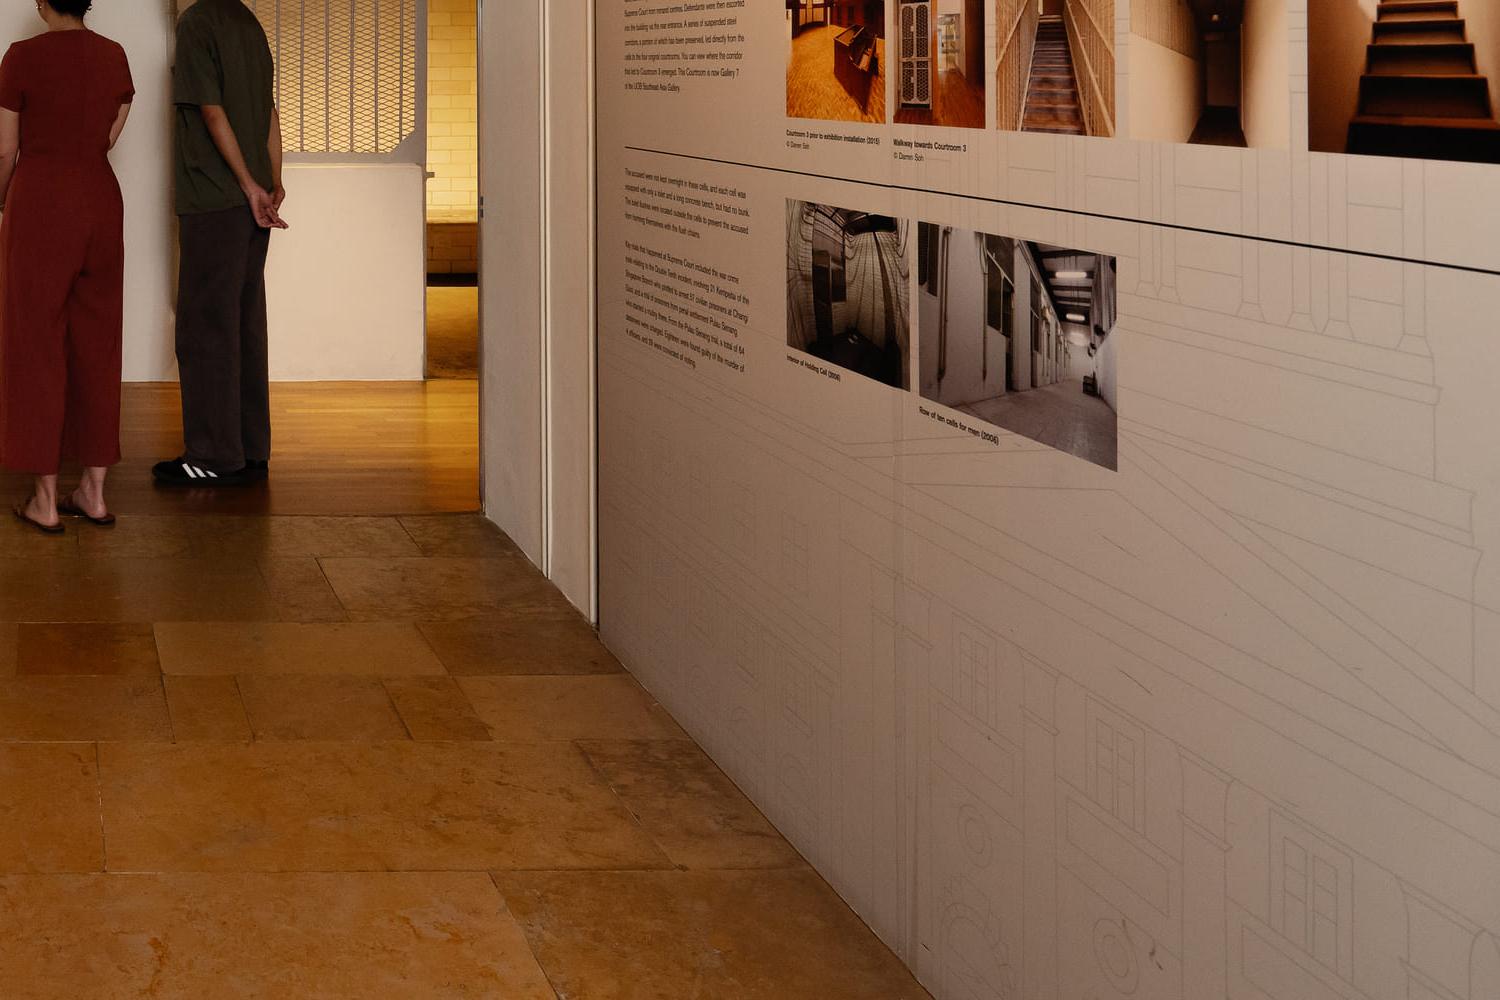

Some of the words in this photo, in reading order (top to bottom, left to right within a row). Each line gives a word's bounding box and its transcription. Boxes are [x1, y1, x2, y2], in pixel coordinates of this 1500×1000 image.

[893, 139, 913, 148] Walkway
[914, 141, 933, 149] towards
[934, 142, 961, 152] Courtroom
[963, 144, 967, 152] 3
[915, 154, 924, 162] Soh
[919, 406, 930, 416] Row
[937, 414, 945, 422] ten
[946, 418, 958, 428] cells
[959, 422, 967, 430] for
[968, 427, 980, 437] men
[981, 430, 999, 446] (2006)
